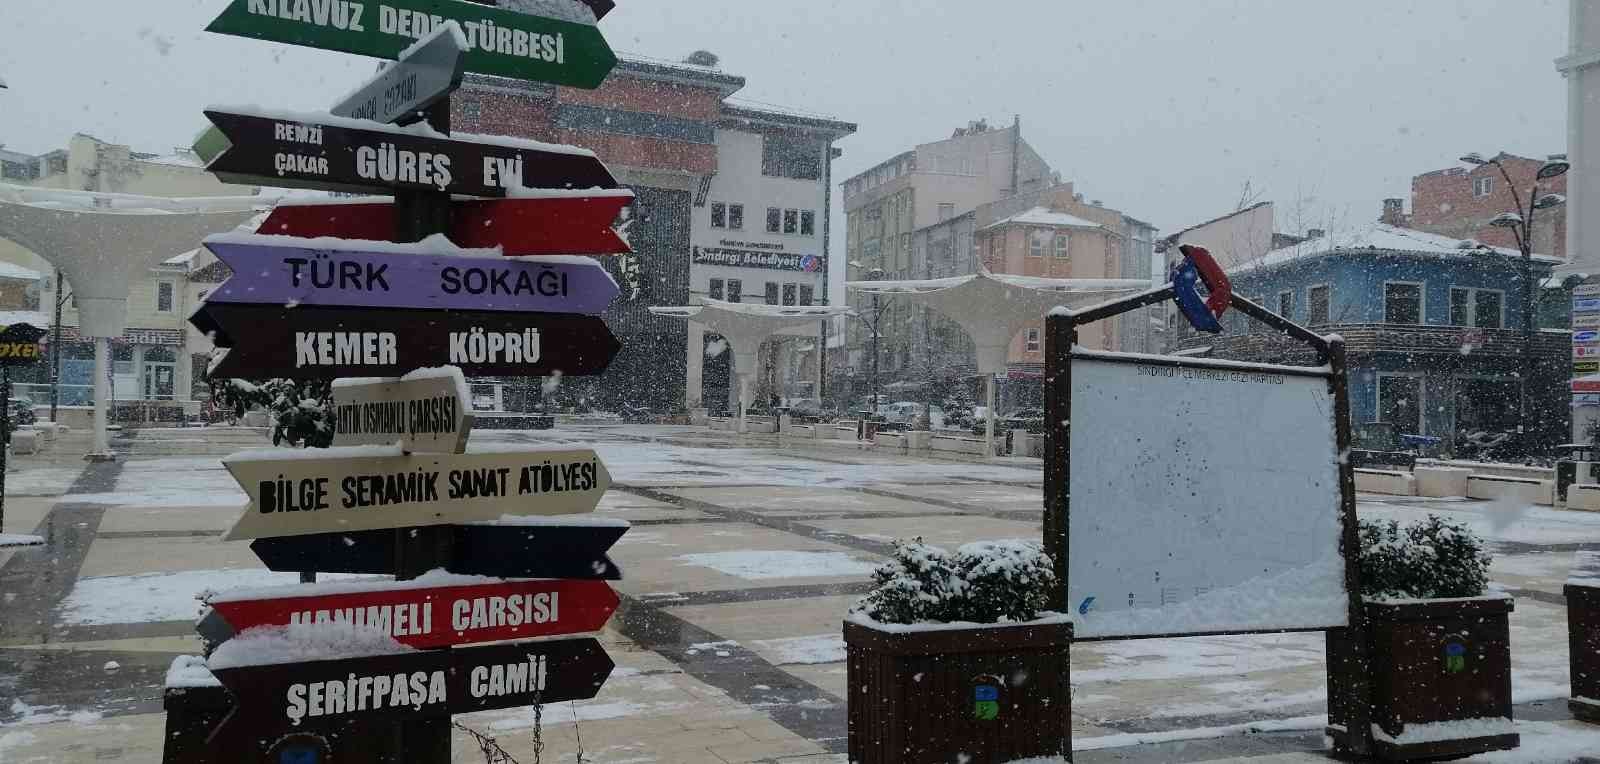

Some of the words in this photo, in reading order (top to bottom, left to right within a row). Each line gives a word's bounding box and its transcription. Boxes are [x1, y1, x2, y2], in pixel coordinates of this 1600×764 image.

[465, 19, 564, 64] TÜRBESİ
[275, 122, 322, 144] REMZİ
[275, 153, 328, 176] ÇAKAR
[356, 143, 452, 192] GÜREŞ
[484, 154, 522, 189] EVİ
[283, 254, 389, 292] TÜRK
[440, 264, 568, 297] SOKAĞI
[296, 331, 397, 368] KEMER
[449, 326, 540, 363] KÖPRÜ
[337, 399, 361, 434] ANTİK
[363, 400, 405, 434] OSMANLI
[259, 474, 329, 514] BİLGE
[342, 466, 440, 508] SERAMİK
[448, 467, 510, 497] SANAT
[518, 457, 598, 495] ATÖLYESİ
[452, 591, 558, 635] ÇARŞISI
[287, 673, 446, 725] ŞERİFPAŞA
